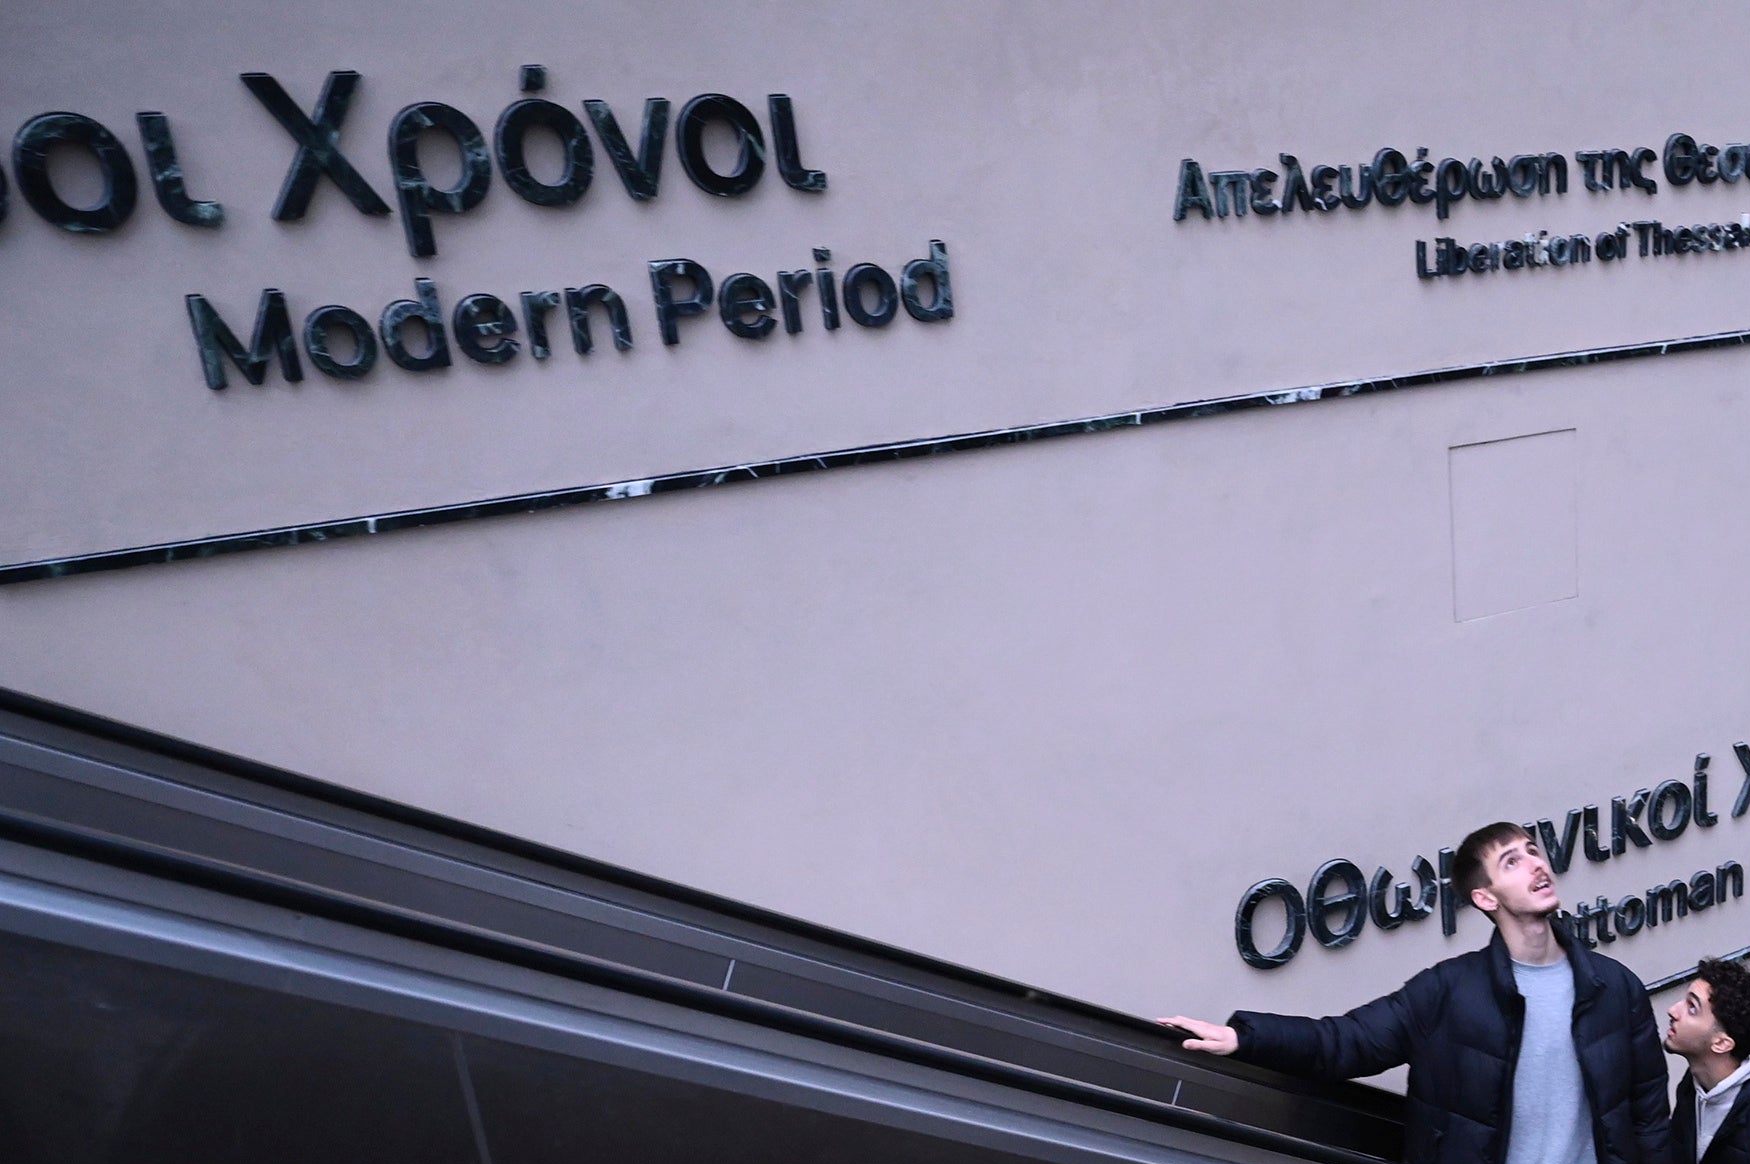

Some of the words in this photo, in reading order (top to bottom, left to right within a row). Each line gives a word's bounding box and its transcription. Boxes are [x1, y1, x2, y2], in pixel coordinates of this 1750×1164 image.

[0, 111, 225, 233] οι
[240, 63, 828, 257] Χρόνοι
[1173, 146, 1569, 222] Απελευθέρωση
[1575, 146, 1658, 195] της
[186, 276, 633, 391] Modern
[649, 239, 956, 346] Period
[1416, 230, 1592, 279] Liberation
[1595, 221, 1631, 261] of
[1235, 752, 1719, 970] Οθωνικοί
